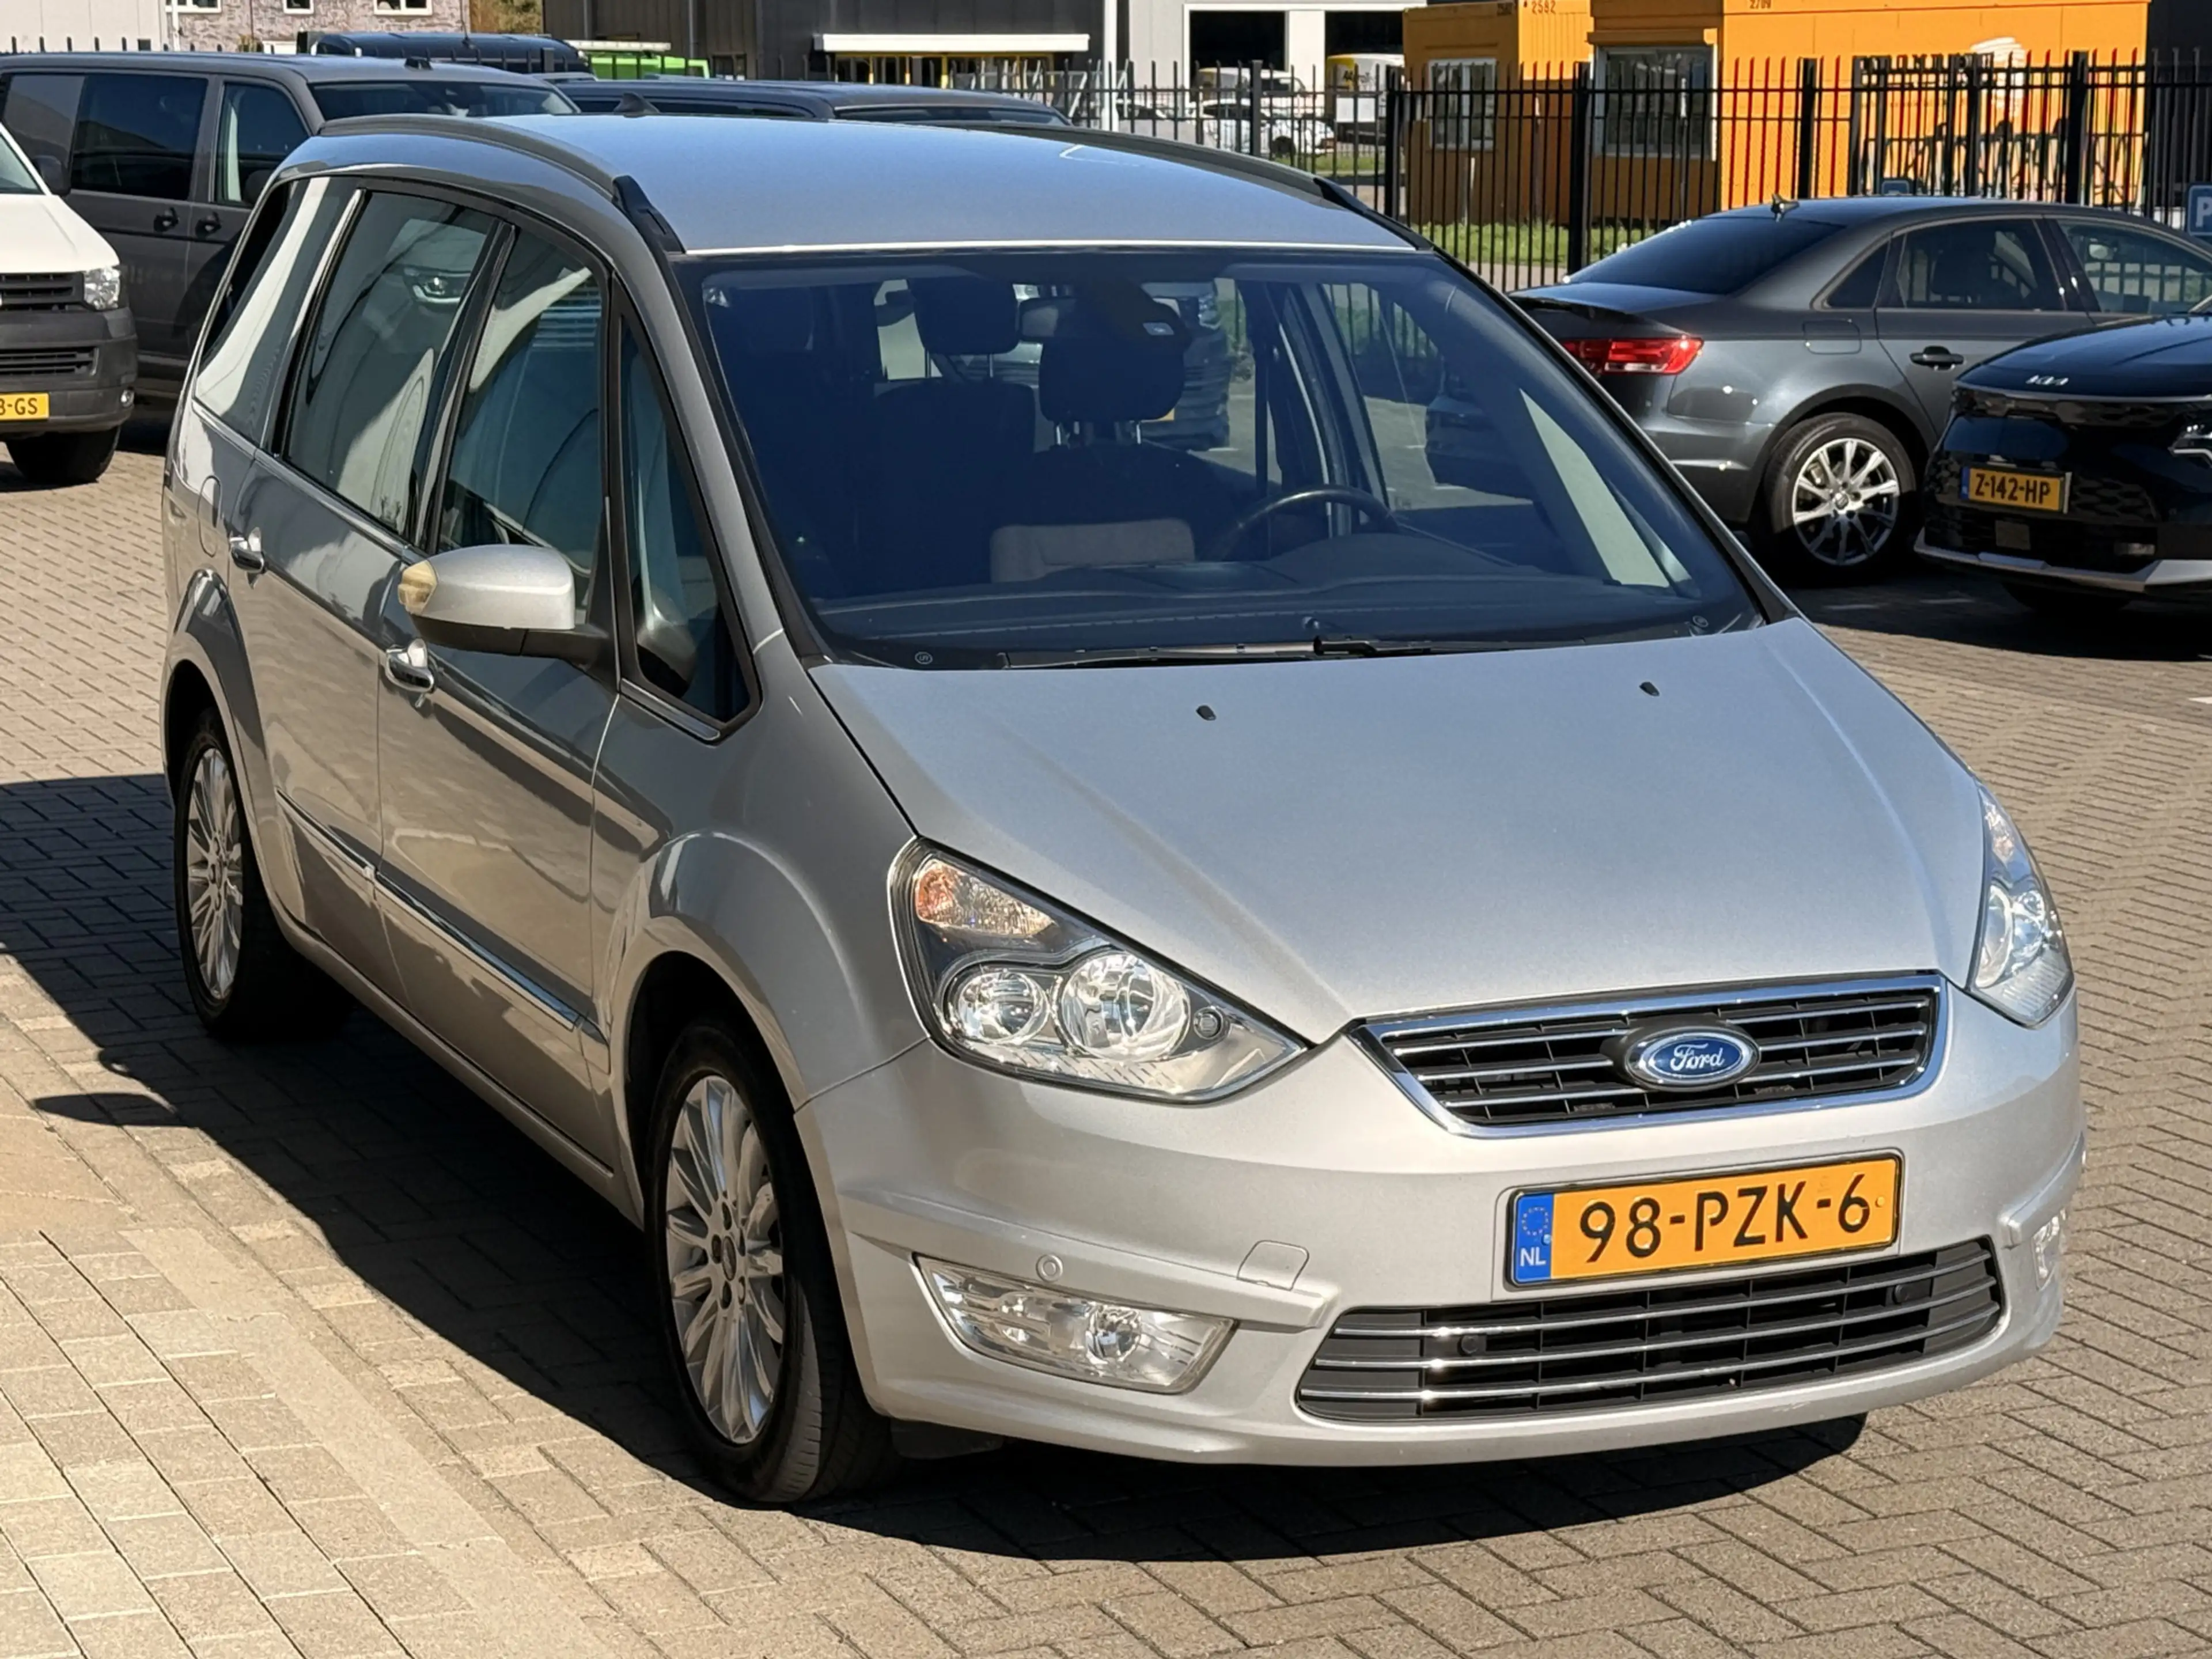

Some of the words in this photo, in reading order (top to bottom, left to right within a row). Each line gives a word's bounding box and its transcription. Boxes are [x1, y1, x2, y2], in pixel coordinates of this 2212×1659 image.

[2195, 196, 2212, 228] P
[1975, 473, 2051, 504] Z-142-HP
[1671, 1043, 1724, 1071] Ford
[1520, 1247, 1546, 1267] NL
[1580, 1174, 1870, 1263] 98-PZK-6
